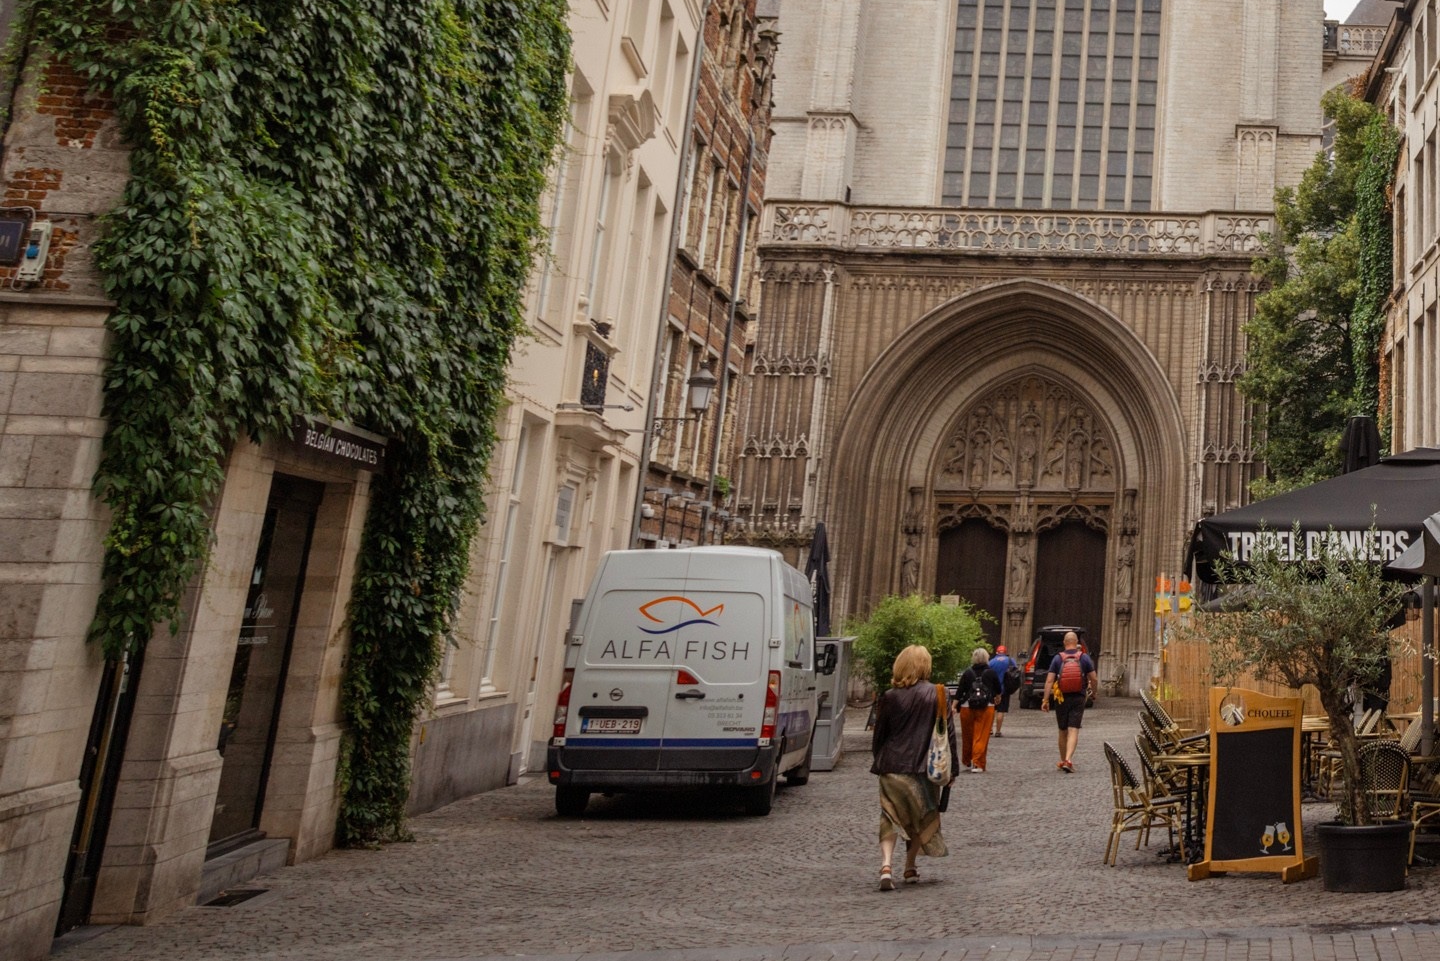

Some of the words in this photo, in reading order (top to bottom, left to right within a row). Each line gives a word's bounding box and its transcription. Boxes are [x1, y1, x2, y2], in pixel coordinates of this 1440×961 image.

[305, 429, 336, 453] BELGIAN
[335, 439, 378, 465] CHOCOLATES
[1228, 531, 1301, 562] TRIPEL
[1306, 530, 1409, 561] D'ANVERS
[600, 640, 671, 659] ALFA
[685, 640, 749, 660] FISH
[1247, 709, 1294, 718] CHOUFFE
[589, 719, 640, 729] 1-UEB-219
